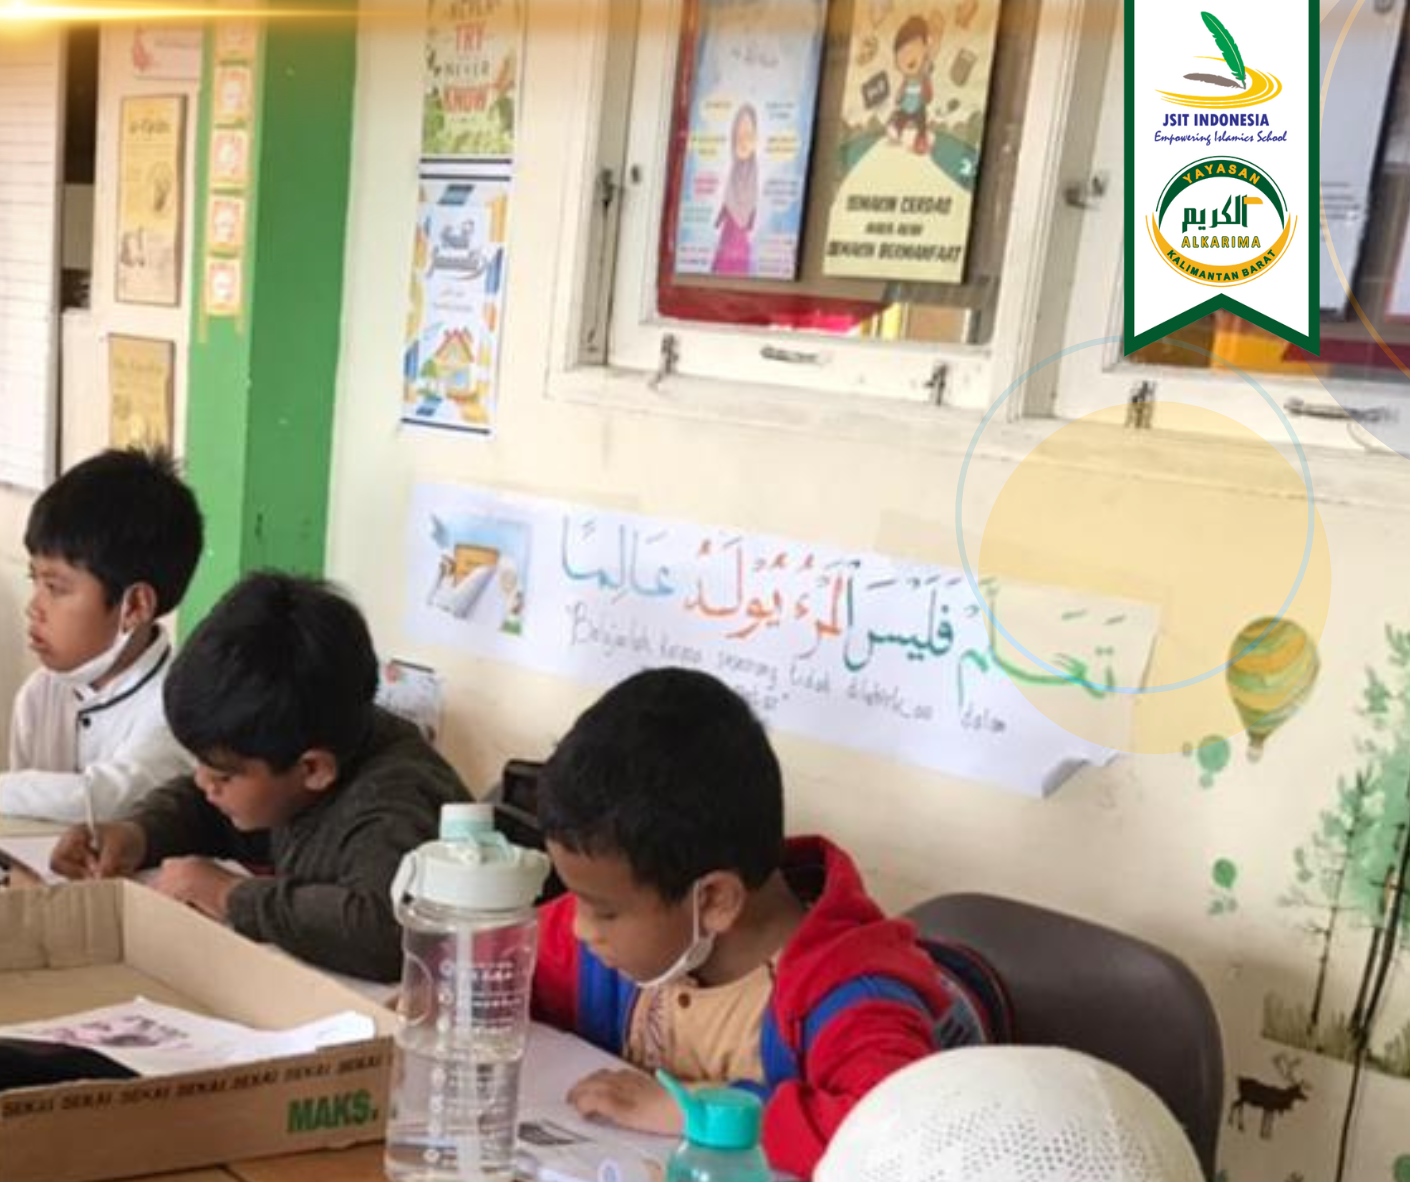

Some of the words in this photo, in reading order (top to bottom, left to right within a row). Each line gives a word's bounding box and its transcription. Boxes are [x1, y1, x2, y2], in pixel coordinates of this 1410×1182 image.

[456, 22, 487, 51] TRY
[442, 83, 487, 112] KNOW
[287, 1088, 379, 1133] MAKS.
